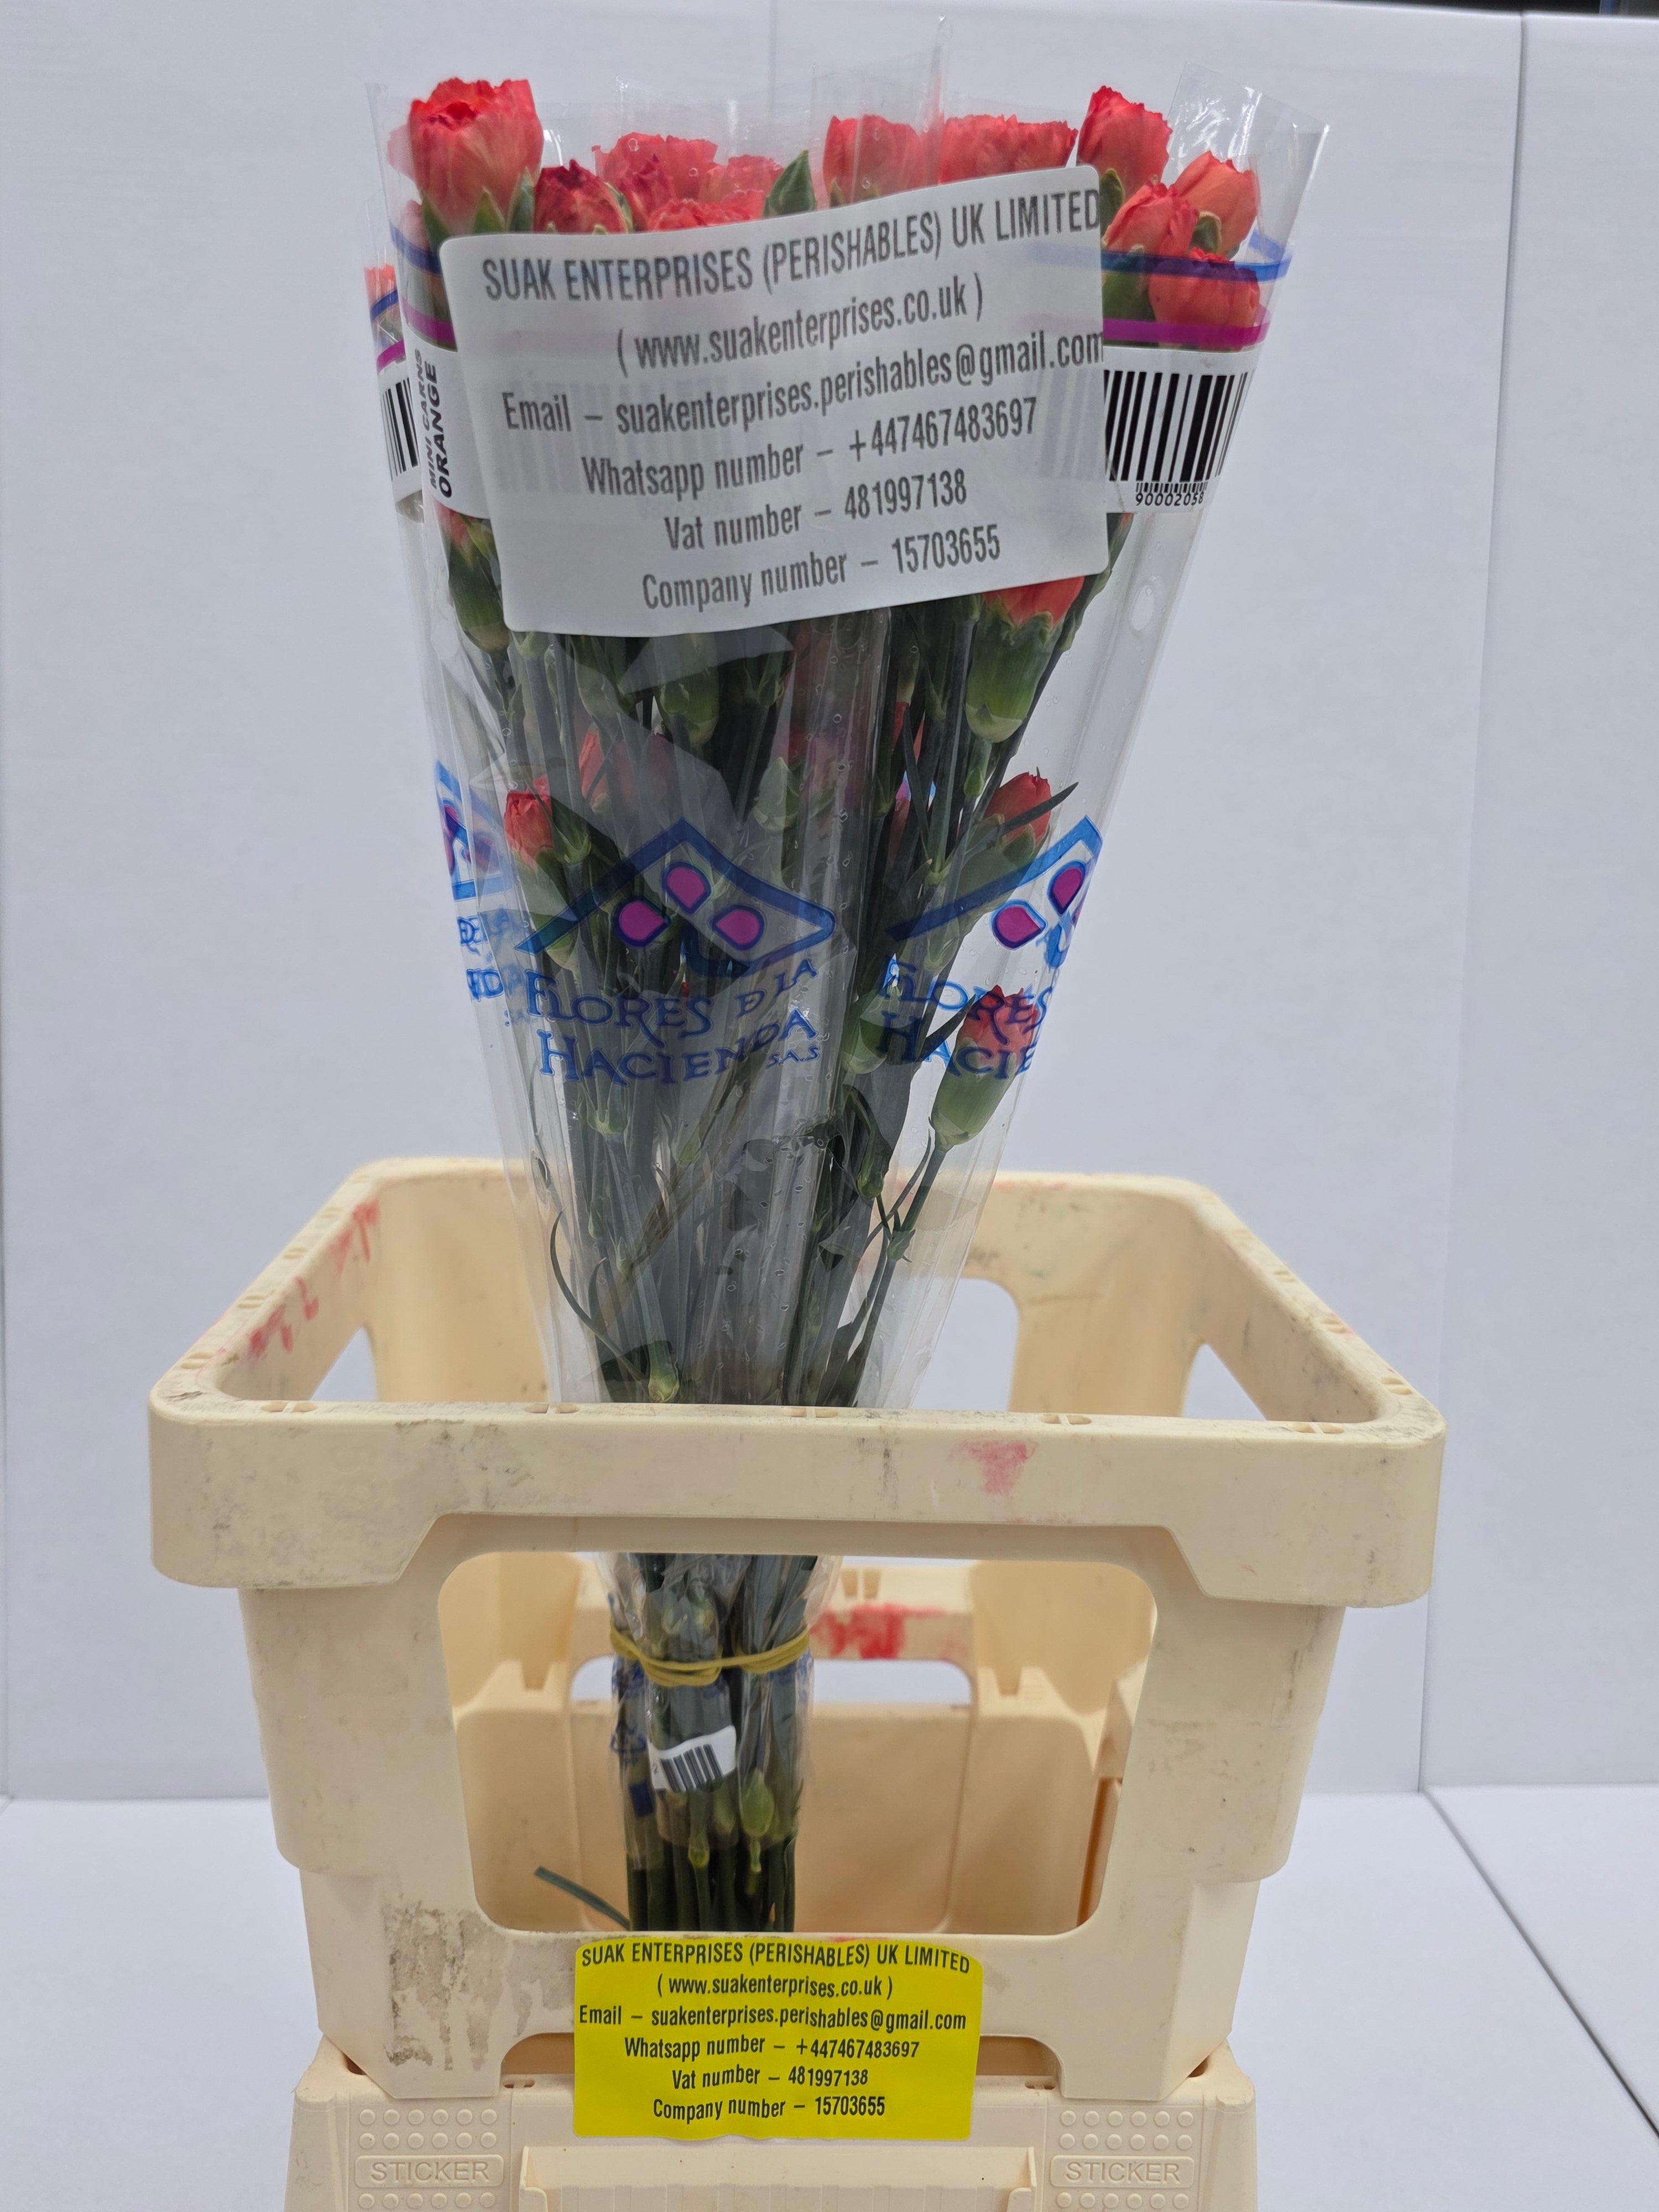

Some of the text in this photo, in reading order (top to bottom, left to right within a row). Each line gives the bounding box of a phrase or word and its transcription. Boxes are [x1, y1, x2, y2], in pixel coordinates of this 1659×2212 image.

[482, 189, 1100, 301] SUAK ENTERPRISES (PERISHABLES) UK LIMITED
[634, 275, 968, 369] www.suakenterprises.co.uk
[502, 392, 572, 432] Email
[615, 330, 1104, 434] suakenterprises.perishables@gmail.com
[415, 348, 437, 490] MINI CARNS
[424, 361, 452, 498] ORANGE
[581, 456, 705, 502] Whatsapp
[714, 443, 804, 490] number
[849, 397, 1037, 462] +447467483697
[664, 515, 704, 551] Vat
[714, 504, 802, 548] number
[844, 468, 967, 520] 481997138
[1135, 491, 1204, 507] 90002058
[642, 570, 752, 613] Company
[761, 551, 848, 597] number
[891, 524, 1001, 575] 15703655
[524, 969, 713, 1050] FLORES
[774, 957, 818, 997] LA
[582, 1942, 971, 1974] SUAK ENTERPRISES (PERISHABLES) UK LIMITED
[668, 1973, 883, 1999] www.suakenterprises.co.uk
[579, 2005, 622, 2025] Email
[651, 2005, 967, 2034] suakenterprises.perishables@gmail.com
[624, 2037, 701, 2063] Whatsapp
[706, 2033, 766, 2056] number
[796, 2038, 920, 2059] +447467483697
[672, 2070, 696, 2090] Vat
[702, 2063, 761, 2088] number
[788, 2065, 869, 2087] 481997138
[653, 2099, 723, 2125] Company
[728, 2098, 786, 2119] number
[815, 2095, 886, 2116] 15703655
[371, 2161, 490, 2182] STICKER
[1065, 2161, 1181, 2182] STICKER
